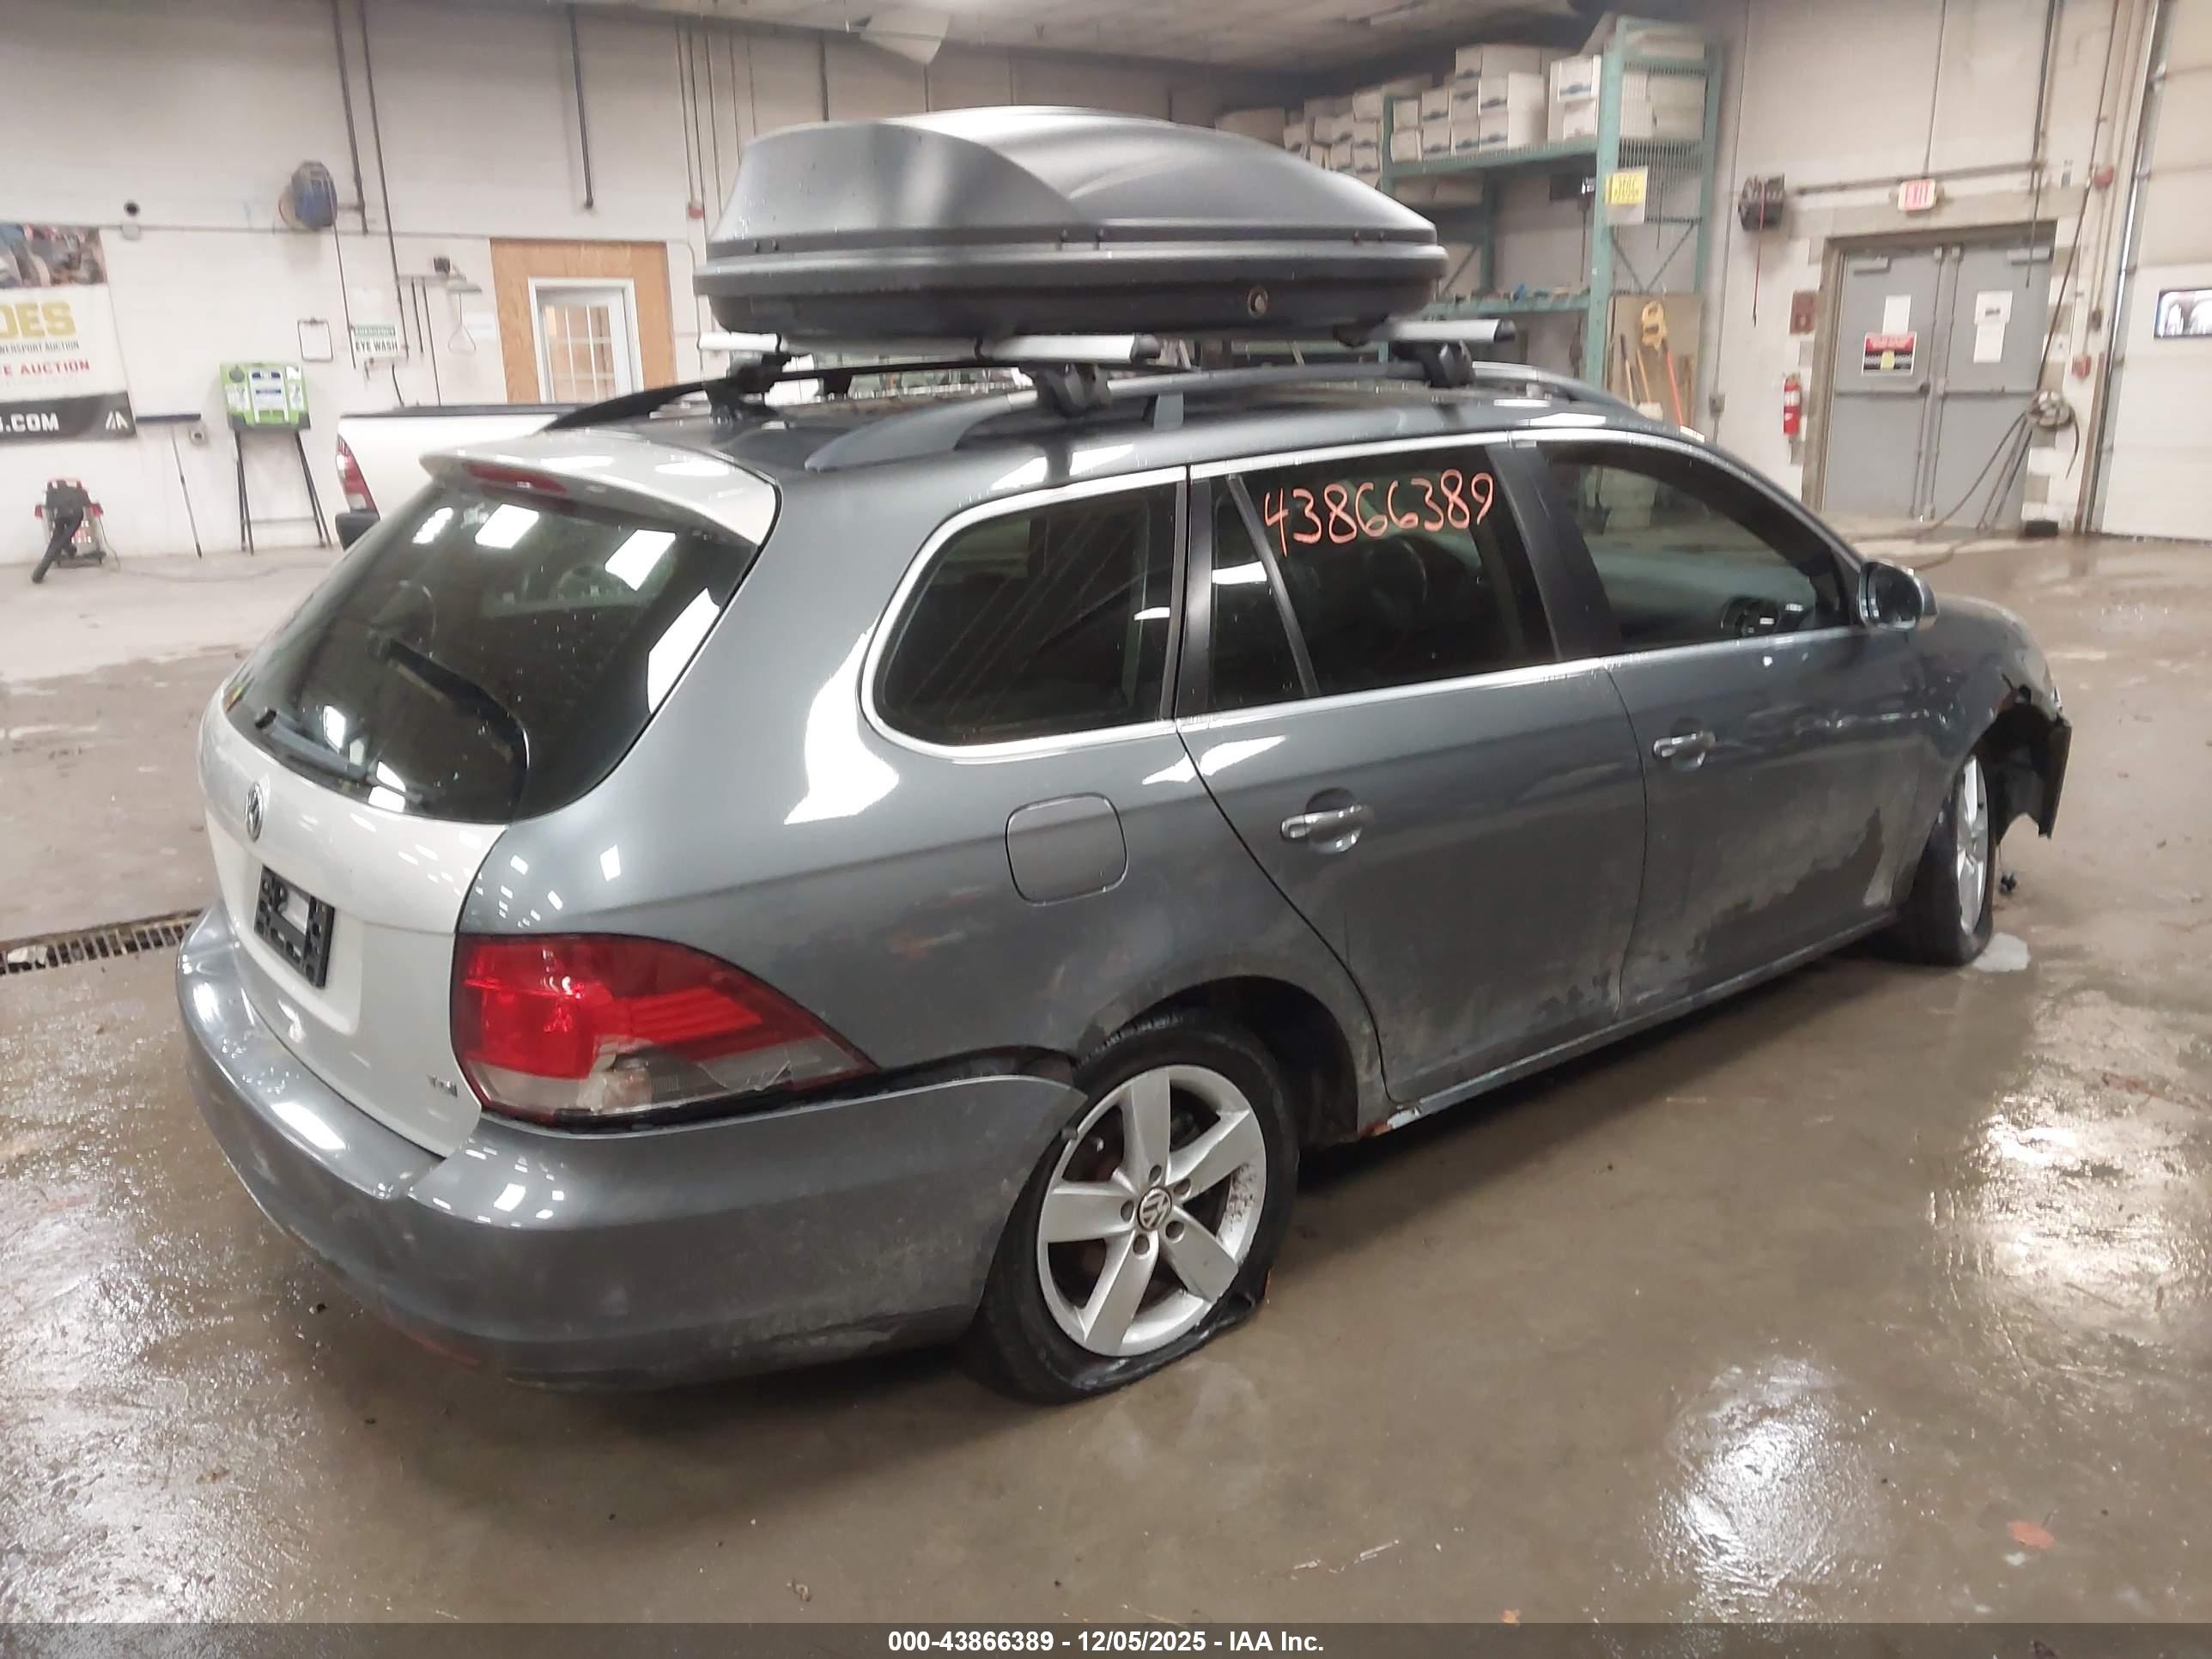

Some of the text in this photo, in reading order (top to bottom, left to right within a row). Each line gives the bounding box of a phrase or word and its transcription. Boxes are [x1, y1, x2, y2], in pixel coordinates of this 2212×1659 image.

[21, 359, 89, 374] AUCTION
[0, 412, 59, 433] .COM
[1264, 468, 1493, 557] 43866389
